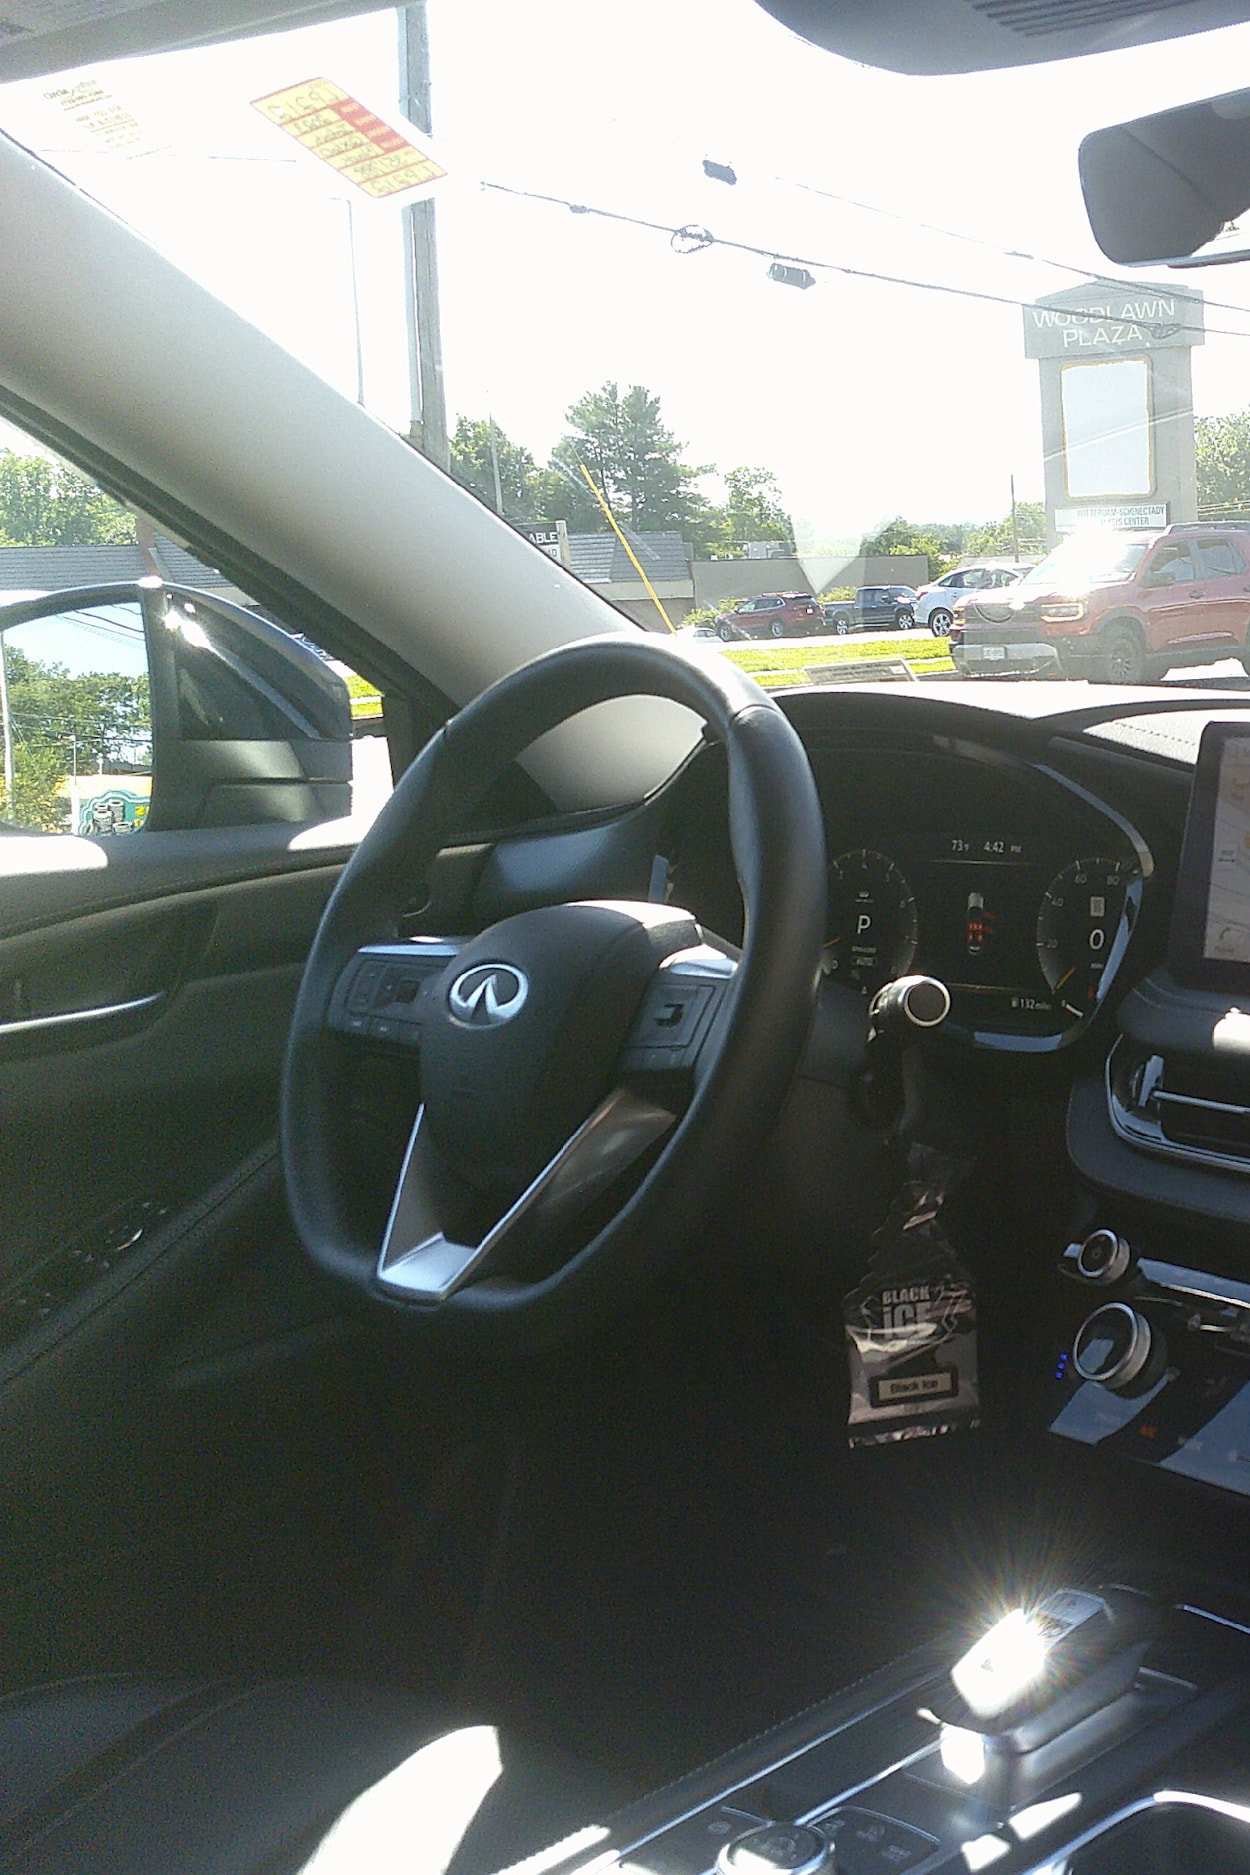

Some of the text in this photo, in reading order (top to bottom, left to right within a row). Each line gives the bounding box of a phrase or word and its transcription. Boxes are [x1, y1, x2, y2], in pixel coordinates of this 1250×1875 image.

[1032, 299, 1176, 328] WOODLAWN
[1063, 324, 1143, 347] PLAZA
[1123, 516, 1150, 526] CENTER
[529, 532, 558, 543] ABLE
[1074, 873, 1088, 886] 60
[856, 914, 873, 936] P
[1045, 938, 1058, 950] 20
[1088, 928, 1105, 951] 0
[1020, 998, 1036, 1011] 132
[882, 1286, 931, 1305] BLACK
[890, 1378, 939, 1394] Black Ice
